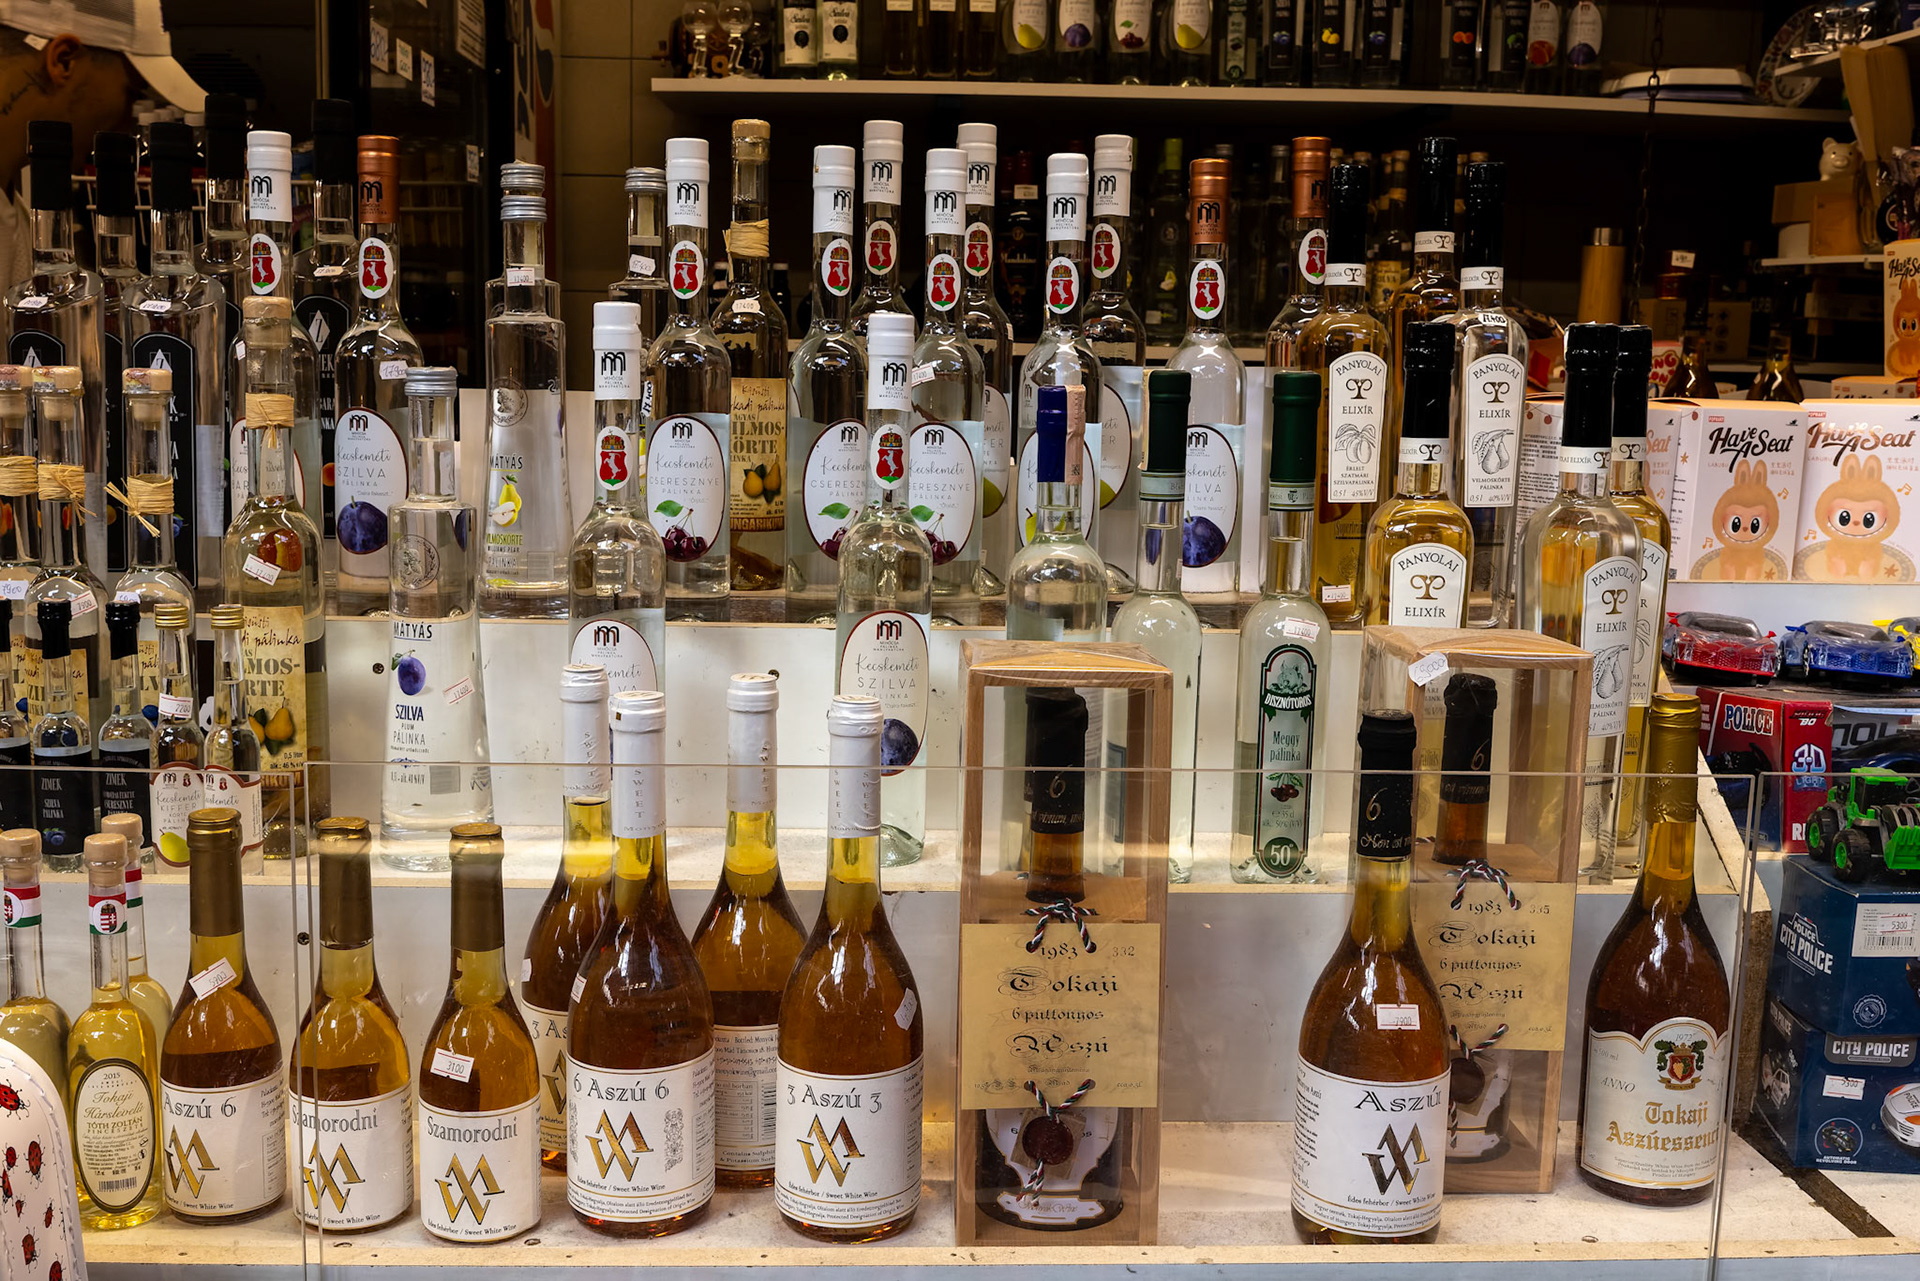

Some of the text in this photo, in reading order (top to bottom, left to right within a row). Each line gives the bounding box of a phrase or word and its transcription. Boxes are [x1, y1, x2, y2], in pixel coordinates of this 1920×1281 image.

[1335, 360, 1383, 376] PANYOLAI
[1472, 362, 1521, 379] PANYOLAI
[1342, 404, 1374, 415] ELIXÍR
[1478, 408, 1511, 418] ELIXÍR
[730, 436, 777, 454] ÖRTE
[1709, 426, 1758, 455] Have
[1751, 429, 1795, 457] Seat
[1808, 421, 1868, 450] Have
[1859, 425, 1917, 451] Seat
[655, 452, 714, 471] Kecskeméti
[337, 467, 386, 478] SZILVA
[650, 476, 720, 487] CSERESZNYE
[1188, 482, 1222, 493] ILVA
[1398, 552, 1460, 572] PANYOLAI
[1591, 566, 1638, 587] PANYOLAI
[1404, 606, 1446, 618] ELIXÍR
[393, 621, 433, 639] MÁTYÁS
[1595, 620, 1628, 633] ELIXÍR
[254, 628, 302, 655] pálinka
[855, 653, 920, 675] Kecskeméti
[857, 676, 917, 690] SZILVA
[394, 704, 425, 722] SZILVA
[1723, 704, 1774, 736] POLICE
[393, 730, 426, 746] PÁLINKA
[1272, 730, 1300, 747] Meggy
[1269, 748, 1301, 763] pálinka
[632, 769, 645, 819] SWEET
[833, 769, 842, 819] SWEET
[160, 803, 197, 812] KIFFER
[1365, 787, 1388, 822] 6
[1468, 899, 1503, 916] 1983
[1434, 924, 1537, 949] Tokaji
[1793, 922, 1816, 943] POLICE
[1039, 942, 1136, 960] 1983 332
[1779, 923, 1834, 975] CITY POLICE
[1451, 959, 1522, 973] puttonyos
[1003, 970, 1119, 996] Tokaji
[1023, 1008, 1104, 1024] puttonyos
[531, 1020, 541, 1040] 3
[1675, 1033, 1692, 1042] 1972
[1832, 1040, 1910, 1058] CITY POLICE
[103, 1072, 121, 1080] 2015
[446, 1061, 465, 1075] 3100
[573, 1072, 670, 1103] 6 Aszú 6
[1600, 1076, 1636, 1093] ANNO
[163, 1092, 211, 1119] Aszú
[220, 1096, 237, 1118] 6
[786, 1080, 883, 1114] 3 Aszú 3
[1354, 1086, 1442, 1114] Aszú
[1645, 1101, 1708, 1127] Tokaji
[427, 1115, 518, 1143] Szamorodni
[631, 1185, 649, 1193] White
[651, 1183, 666, 1191] Wine
[825, 1191, 843, 1199] Sweet
[1347, 1195, 1362, 1204] Édes
[1362, 1197, 1390, 1207] fehérbor
[365, 1213, 381, 1222] Wine
[464, 1227, 482, 1235] Sweet
[483, 1226, 502, 1234] White
[502, 1223, 517, 1231] Wine
